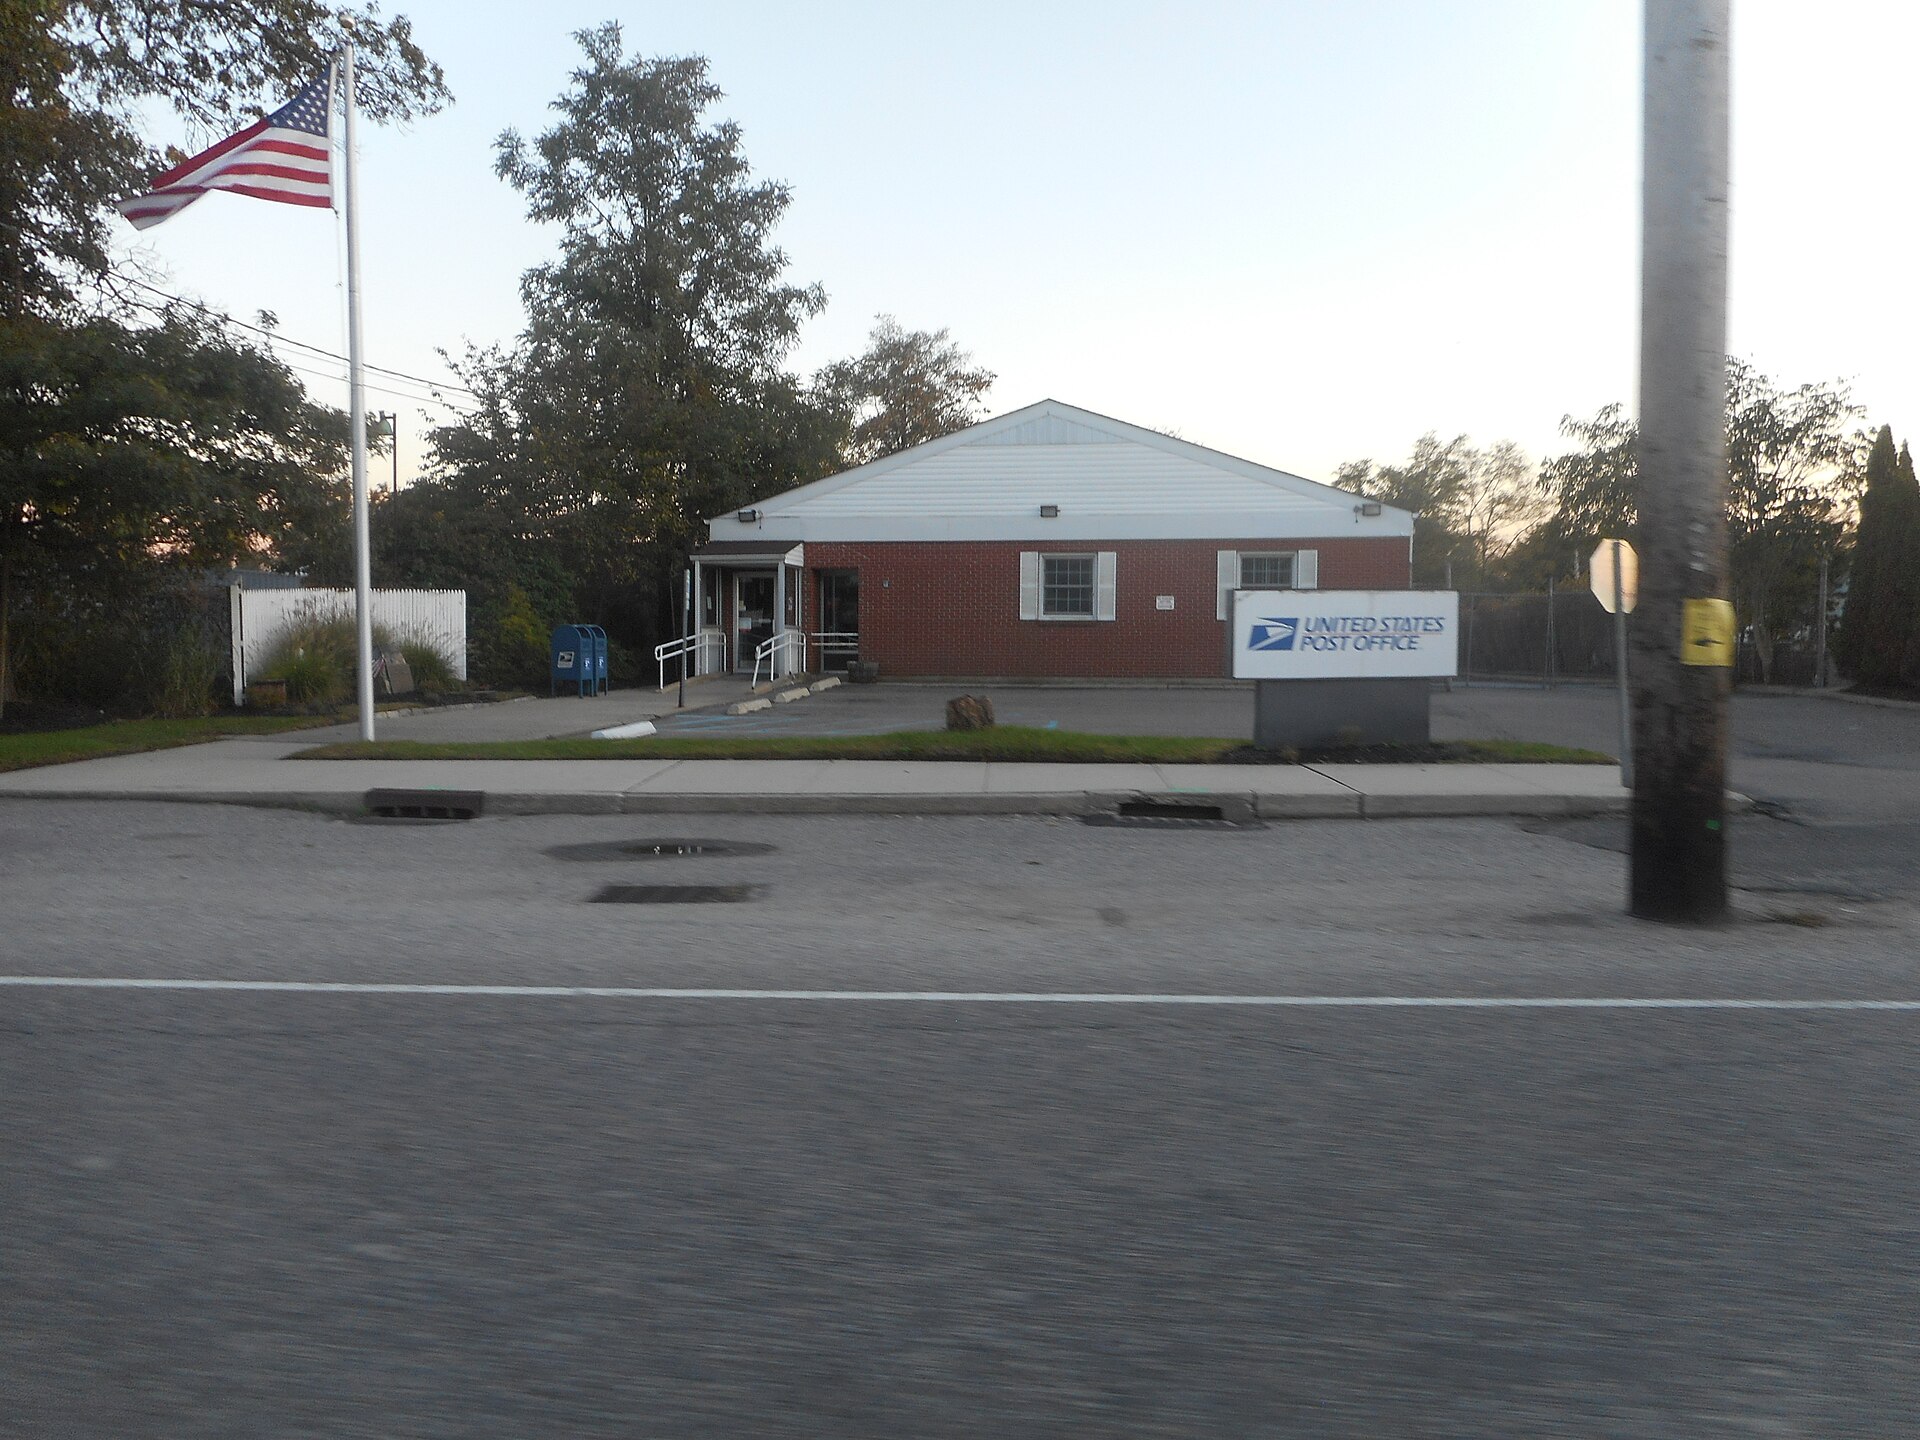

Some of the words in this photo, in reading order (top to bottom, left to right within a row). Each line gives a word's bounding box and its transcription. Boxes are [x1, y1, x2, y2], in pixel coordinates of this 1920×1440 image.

[1305, 617, 1376, 632] UNITED
[1380, 617, 1445, 632] STATES
[1299, 636, 1352, 651] POST
[1353, 636, 1421, 651] OFFICE
